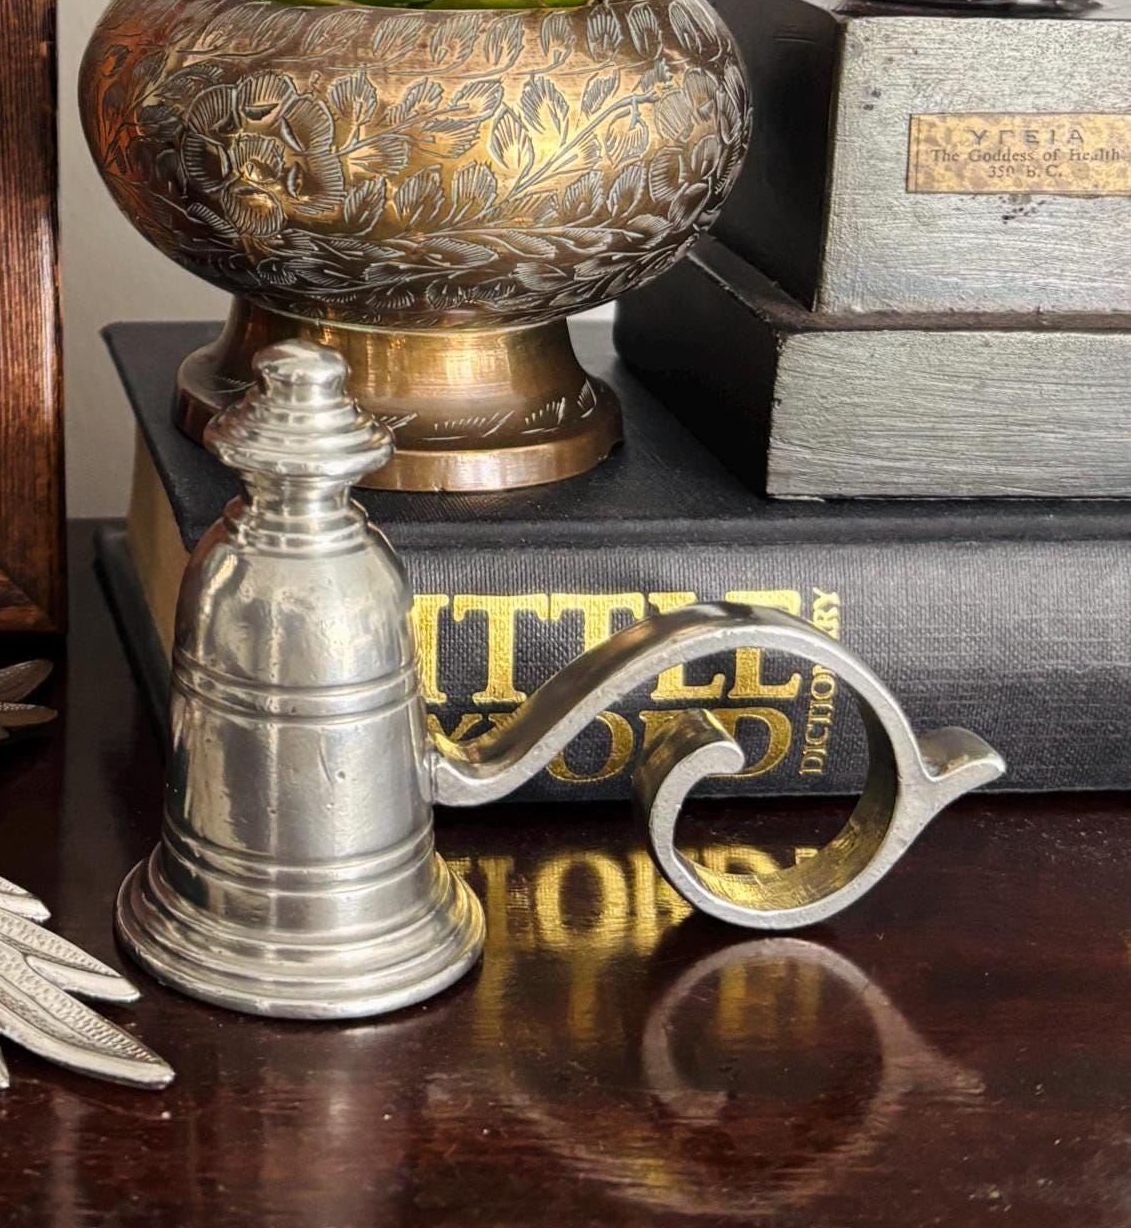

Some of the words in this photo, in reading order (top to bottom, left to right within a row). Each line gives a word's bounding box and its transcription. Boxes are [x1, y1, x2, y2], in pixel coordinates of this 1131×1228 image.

[930, 148, 960, 162] The
[969, 147, 1035, 162] Goddess
[1042, 148, 1061, 162] of
[1069, 148, 1120, 161] Health
[988, 165, 1015, 178] 350
[413, 591, 802, 703] ITTLE
[799, 587, 841, 775] DICTIORY
